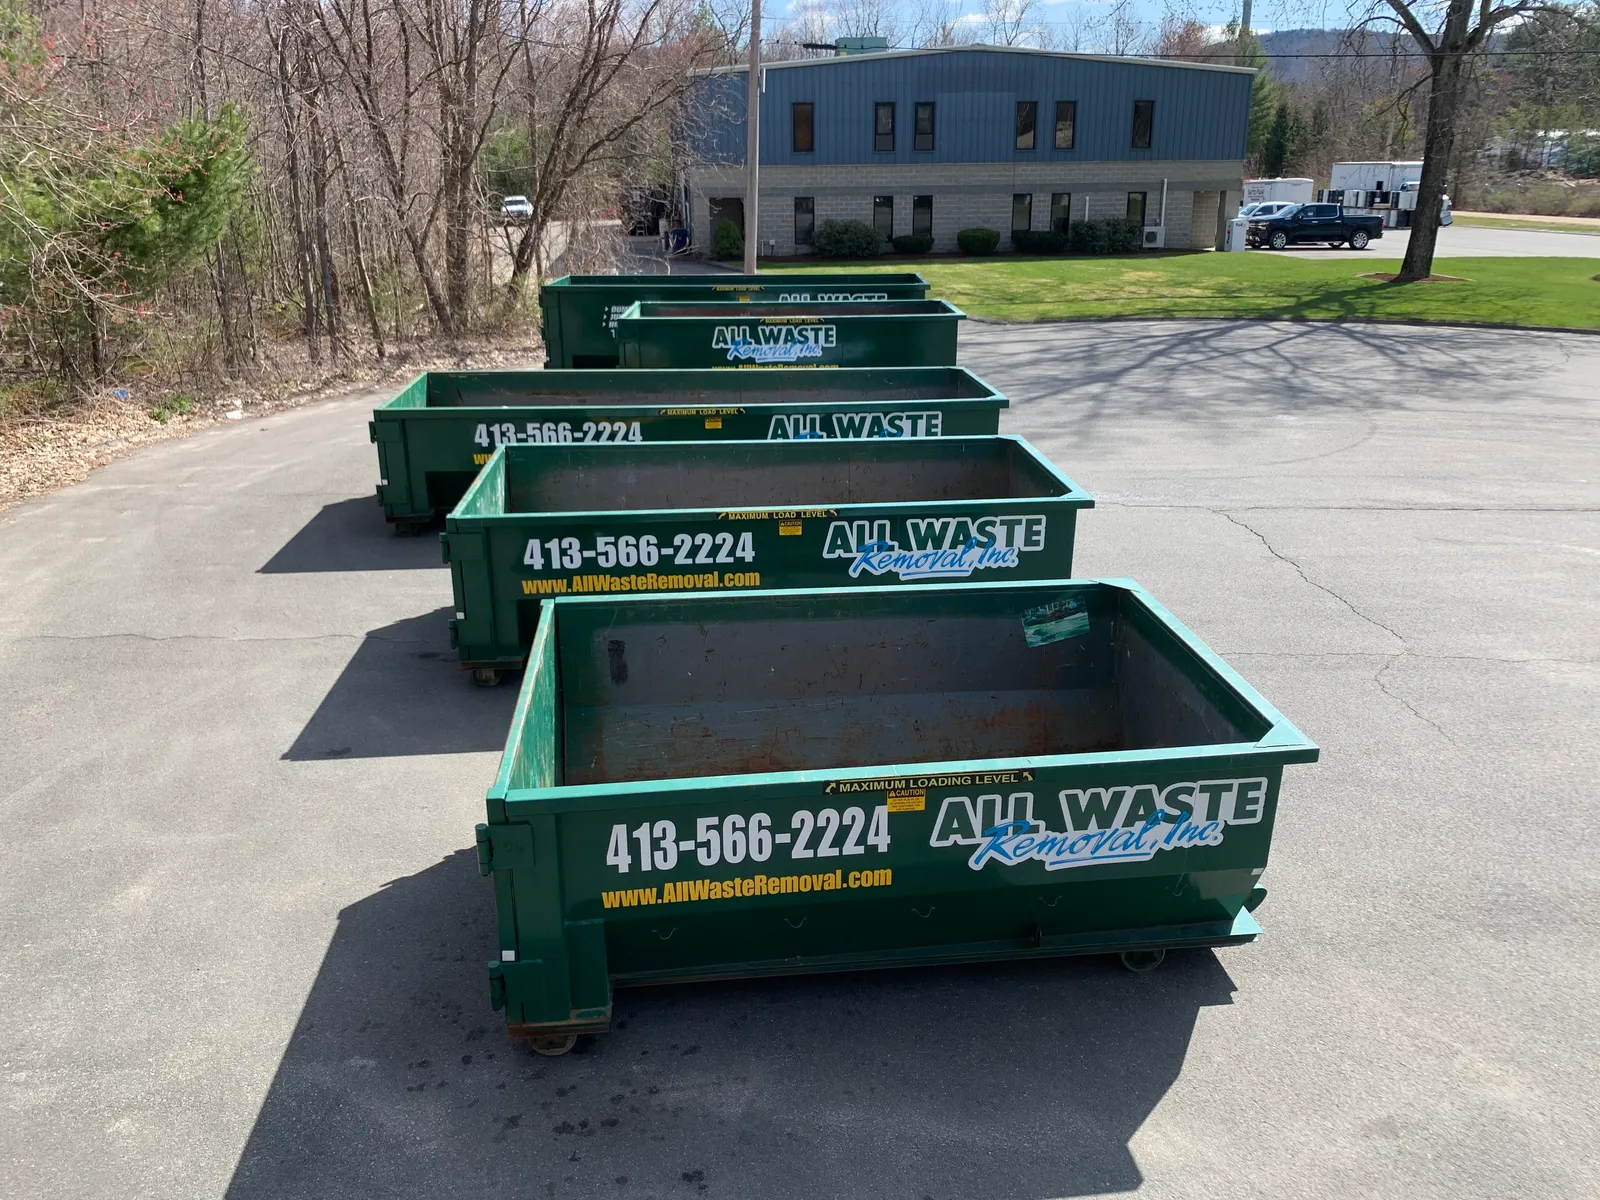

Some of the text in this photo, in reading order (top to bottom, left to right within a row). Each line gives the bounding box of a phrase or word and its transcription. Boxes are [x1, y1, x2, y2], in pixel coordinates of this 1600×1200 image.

[712, 325, 836, 348] ALL WASTE
[474, 421, 643, 447] 413-566-2224
[767, 411, 942, 440] ALL WASTE
[728, 510, 827, 520] MAXIMUM LOAD LEVEL
[823, 514, 1047, 559] ALL WASTE
[523, 532, 755, 570] 413-566-2224
[522, 571, 760, 595] www.AllWasteRemoval.com
[839, 774, 1019, 793] MAXIMUM LOADING LEVEL
[896, 789, 924, 797] CAUTION
[930, 777, 1268, 847] ALL WASTE
[606, 805, 891, 873] 413-566-2224
[602, 868, 892, 908] www.AllWasteRemoval.com
